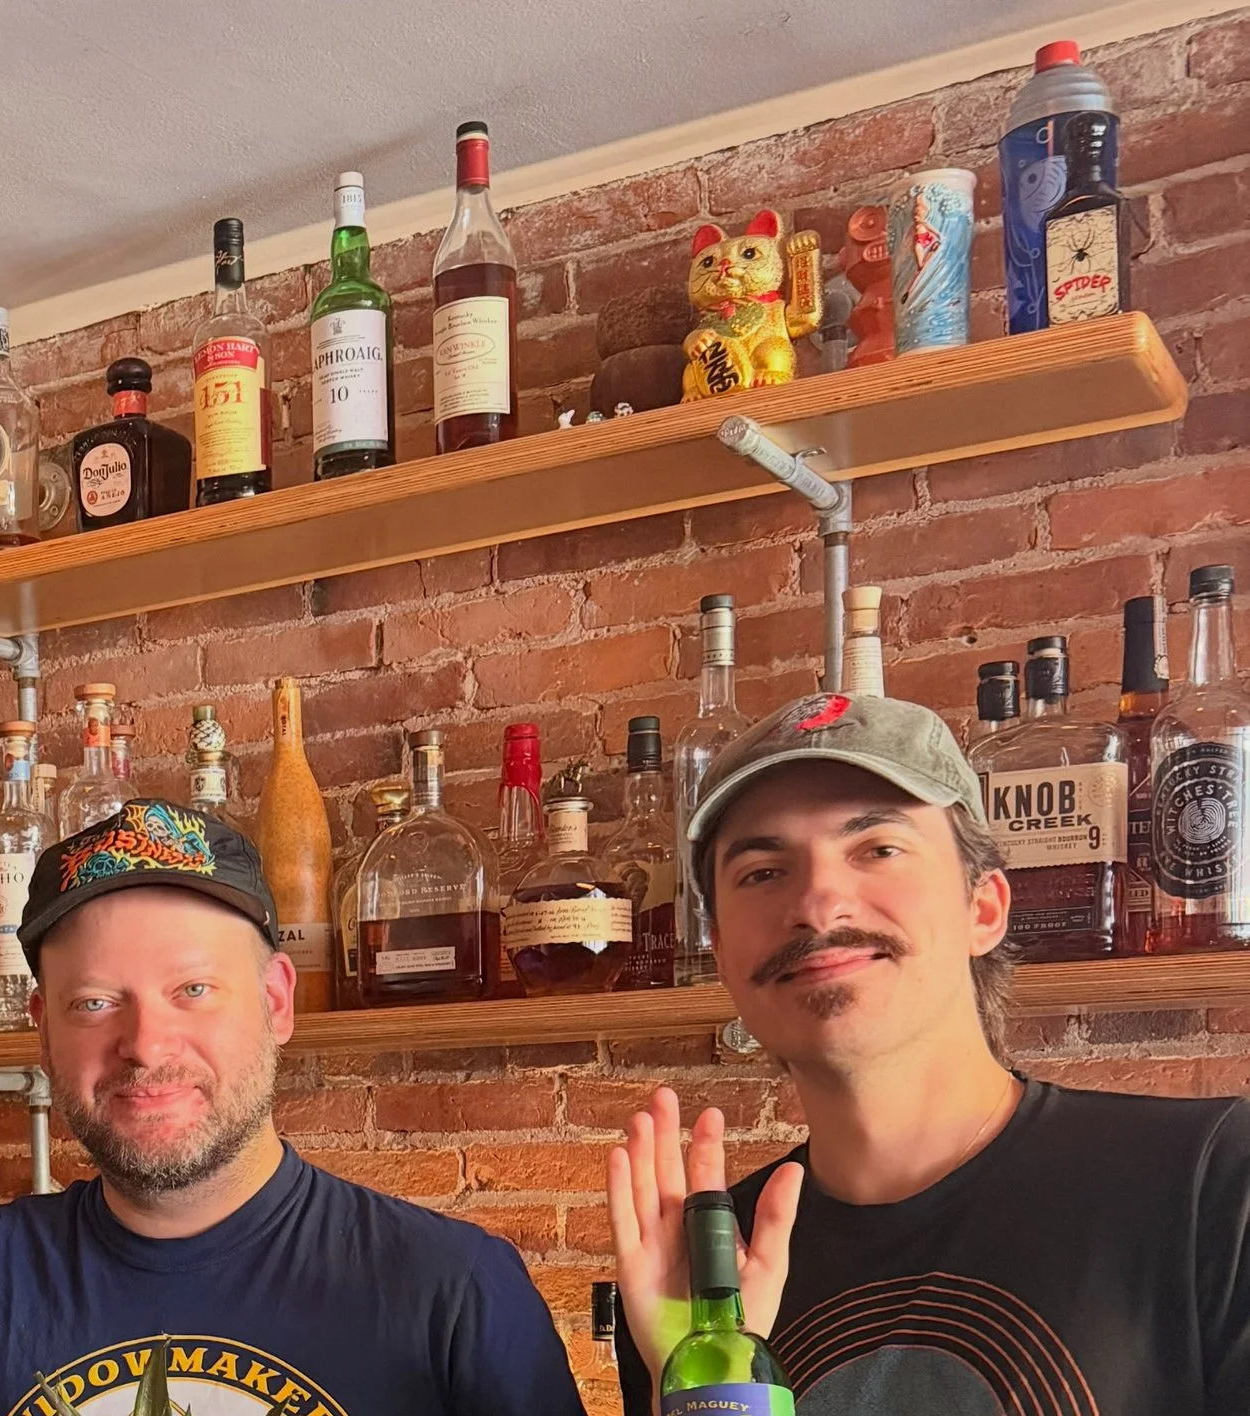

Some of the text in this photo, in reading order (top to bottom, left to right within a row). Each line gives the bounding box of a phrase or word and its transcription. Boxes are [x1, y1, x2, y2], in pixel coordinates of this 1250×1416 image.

[1053, 274, 1112, 301] SPIDER
[215, 351, 236, 360] SON
[199, 381, 243, 410] 151
[331, 386, 349, 404] 10
[993, 779, 1076, 821] KNOB
[1222, 790, 1239, 830] TREE
[1008, 813, 1093, 832] CREEK
[1027, 836, 1057, 846] STRAIGHT
[1057, 833, 1088, 842] BOURBON
[1088, 825, 1101, 850] 9
[420, 883, 467, 894] RESERVE
[1033, 922, 1067, 930] PROOF
[642, 932, 675, 952] TRACE
[686, 1400, 750, 1413] MAGUEY
